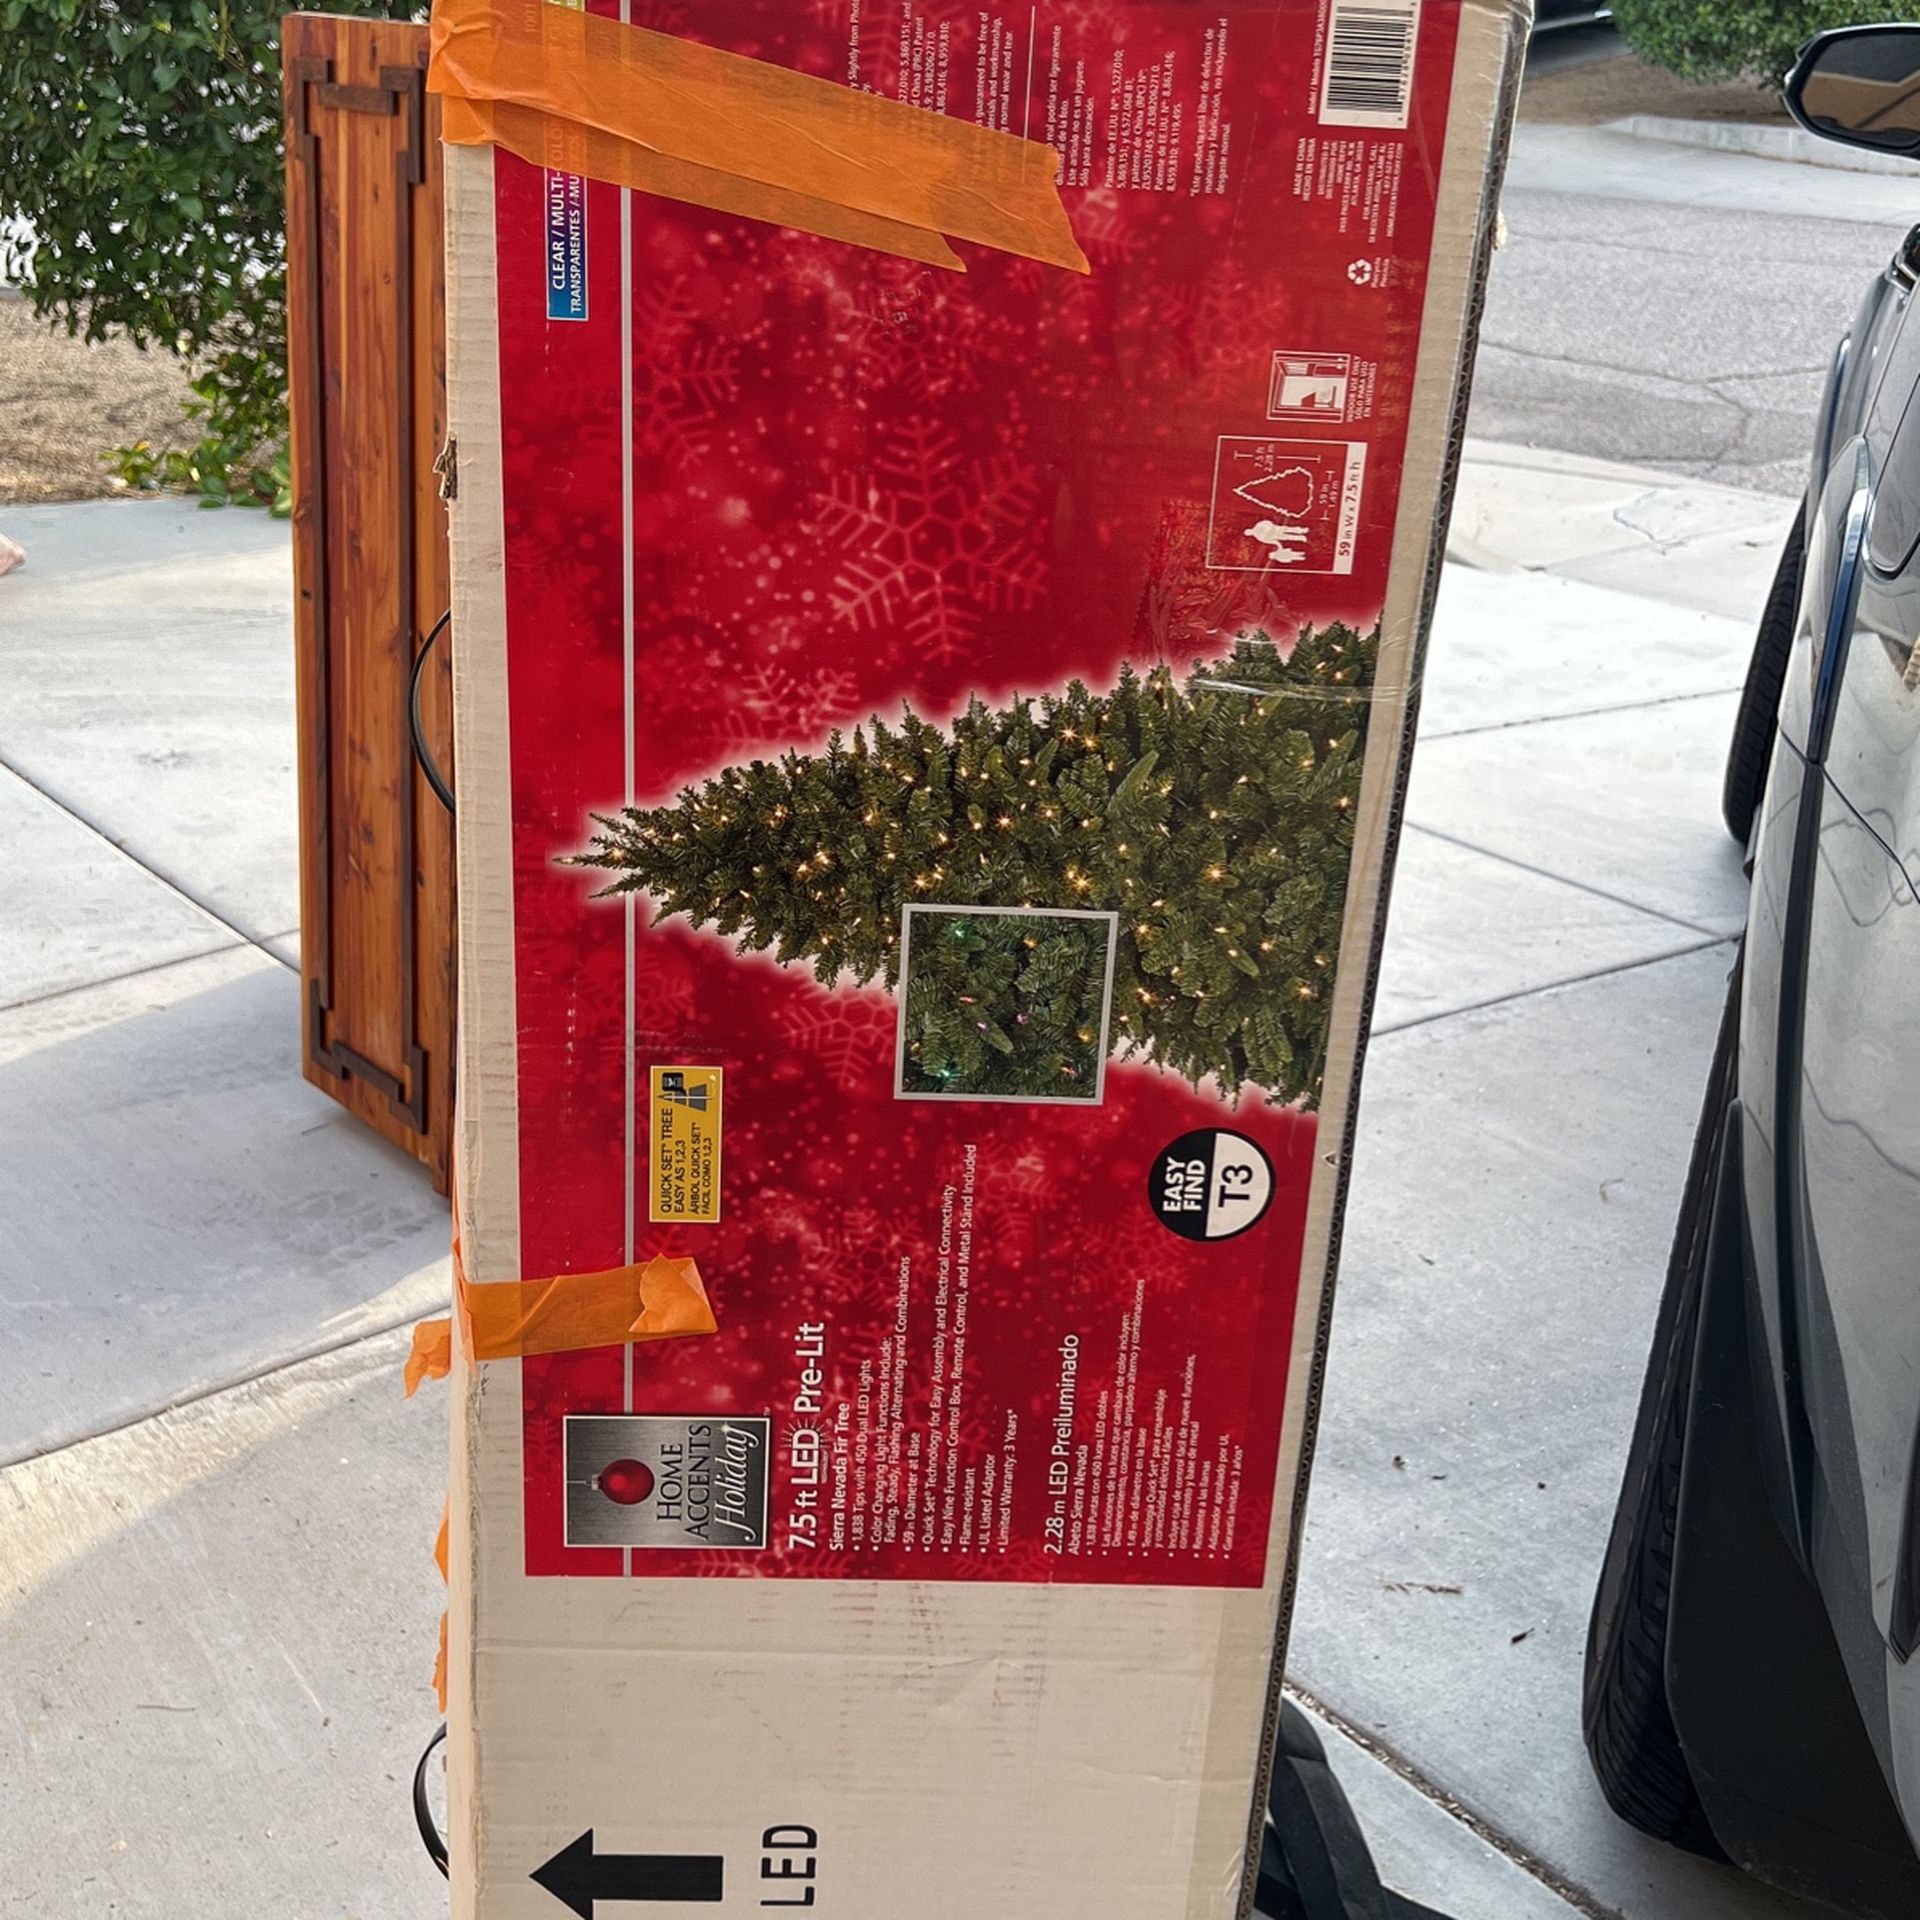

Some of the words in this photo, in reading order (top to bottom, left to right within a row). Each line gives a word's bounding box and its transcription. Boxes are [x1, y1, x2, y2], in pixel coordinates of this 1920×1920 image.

[979, 12, 989, 22] of
[849, 25, 859, 46] from
[914, 17, 924, 45] Patent
[977, 24, 988, 41] free
[1004, 30, 1014, 49] tear.
[913, 48, 924, 71] (PRC)
[978, 43, 987, 55] be
[990, 17, 1003, 78] workmanship,
[1003, 51, 1012, 68] and
[849, 49, 861, 80] Slightly
[977, 57, 987, 66] to
[911, 73, 921, 97] China
[988, 80, 998, 97] and
[1003, 70, 1011, 92] wear
[1073, 59, 1086, 94] juguete.
[976, 68, 988, 118] guaranteed
[1073, 95, 1082, 107] un
[1000, 95, 1010, 125] normal
[1072, 109, 1081, 119] es
[1071, 121, 1080, 132] no
[1296, 137, 1306, 161] CHINA
[1067, 168, 1077, 186] Este
[1295, 163, 1304, 171] IN
[1293, 172, 1303, 195] MADE
[552, 241, 565, 290] CLEAR
[569, 209, 582, 313] TRANSPARENTES
[1351, 355, 1360, 375] ONLY
[1348, 377, 1358, 392] USE
[1346, 393, 1356, 422] INDOOR
[1256, 446, 1265, 454] ft
[1268, 443, 1275, 453] m
[1254, 455, 1264, 469] 7.5
[1265, 454, 1274, 472] 2.28
[1350, 461, 1361, 470] h
[1321, 483, 1329, 492] in
[1332, 480, 1339, 489] m
[1348, 472, 1360, 482] ft
[1320, 494, 1328, 505] 59
[1329, 491, 1338, 508] 1.49
[1346, 484, 1357, 503] 7.5
[1343, 515, 1354, 527] W
[1341, 530, 1352, 540] in
[1338, 541, 1351, 557] 59
[662, 1108, 673, 1140] TREE
[676, 1140, 687, 1164] 1,2,3
[703, 1137, 712, 1157] 1,2,3
[675, 1167, 684, 1182] AS
[691, 1147, 700, 1178] QUICK
[702, 1160, 711, 1188] COMO
[963, 1144, 976, 1193] Included
[660, 1174, 672, 1213] QUICK
[1162, 1156, 1186, 1212] EASY
[1183, 1159, 1206, 1211] FIND
[1218, 1164, 1253, 1208] T3
[675, 1185, 685, 1213] EASY
[688, 1181, 699, 1214] ÁRBOL
[701, 1190, 711, 1214] FÁCIL
[940, 1185, 956, 1255] Connectivity
[961, 1196, 973, 1229] Stand
[959, 1231, 971, 1264] Metal
[937, 1258, 950, 1305] Electrical
[957, 1267, 969, 1289] and
[895, 1256, 910, 1333] Combinations
[936, 1309, 947, 1329] and
[954, 1292, 969, 1335] Control,
[879, 1337, 891, 1379] Include:
[894, 1335, 906, 1357] and
[932, 1332, 948, 1383] Assembly
[951, 1337, 965, 1379] Remote
[794, 1322, 825, 1412] Pre-Lit
[858, 1360, 873, 1392] Lights
[891, 1359, 907, 1420] Alternating
[931, 1386, 946, 1408] Easy
[950, 1383, 964, 1405] Box,
[1052, 1335, 1078, 1456] Preiluminado
[836, 1403, 850, 1432] Tree
[857, 1395, 869, 1415] LED
[877, 1382, 889, 1433] Functions
[1097, 1391, 1107, 1420] dobles
[856, 1418, 868, 1443] Dual
[930, 1412, 941, 1427] for
[947, 1408, 961, 1447] Control
[1095, 1421, 1105, 1438] LED
[835, 1437, 848, 1454] Fir
[855, 1445, 868, 1464] 450
[875, 1436, 890, 1461] Light
[889, 1422, 904, 1464] Flashing
[908, 1433, 921, 1457] Base
[1094, 1440, 1104, 1460] luces
[791, 1429, 820, 1485] LED
[907, 1460, 919, 1470] at
[926, 1430, 943, 1488] Technology
[1074, 1445, 1088, 1486] Nevada
[1092, 1461, 1102, 1477] 450
[657, 1444, 683, 1521] HOME
[685, 1425, 711, 1540] ACCENTS
[715, 1423, 759, 1542] Holiday
[832, 1458, 848, 1509] Nevada
[854, 1467, 867, 1490] with
[944, 1449, 958, 1494] Function
[982, 1454, 997, 1497] Adaptor
[1001, 1455, 1016, 1506] Warranty:
[1049, 1462, 1069, 1495] LED
[873, 1464, 889, 1514] Changing
[887, 1468, 902, 1503] Steady,
[905, 1473, 919, 1520] Diameter
[1093, 1479, 1101, 1494] con
[796, 1490, 817, 1508] ft
[853, 1492, 869, 1512] Tips
[943, 1496, 956, 1520] Nine
[960, 1468, 975, 1545] Flame-resistant
[1052, 1501, 1067, 1514] m
[1071, 1489, 1084, 1519] Sierra
[1089, 1496, 1100, 1523] Puntas
[885, 1507, 900, 1543] Fading,
[980, 1500, 992, 1529] Listed
[998, 1508, 1011, 1546] Limited
[789, 1513, 816, 1549] 7.5
[830, 1513, 845, 1551] Sierra
[852, 1515, 867, 1541] 1,838
[872, 1516, 884, 1543] Color
[904, 1531, 916, 1543] 59
[923, 1516, 939, 1544] Quick
[941, 1522, 957, 1545] Easy
[979, 1532, 991, 1545] UL
[1045, 1518, 1065, 1555] 2.28
[1068, 1522, 1082, 1555] Abeto
[1087, 1525, 1099, 1546] 1,838
[760, 1825, 817, 1906] LED
